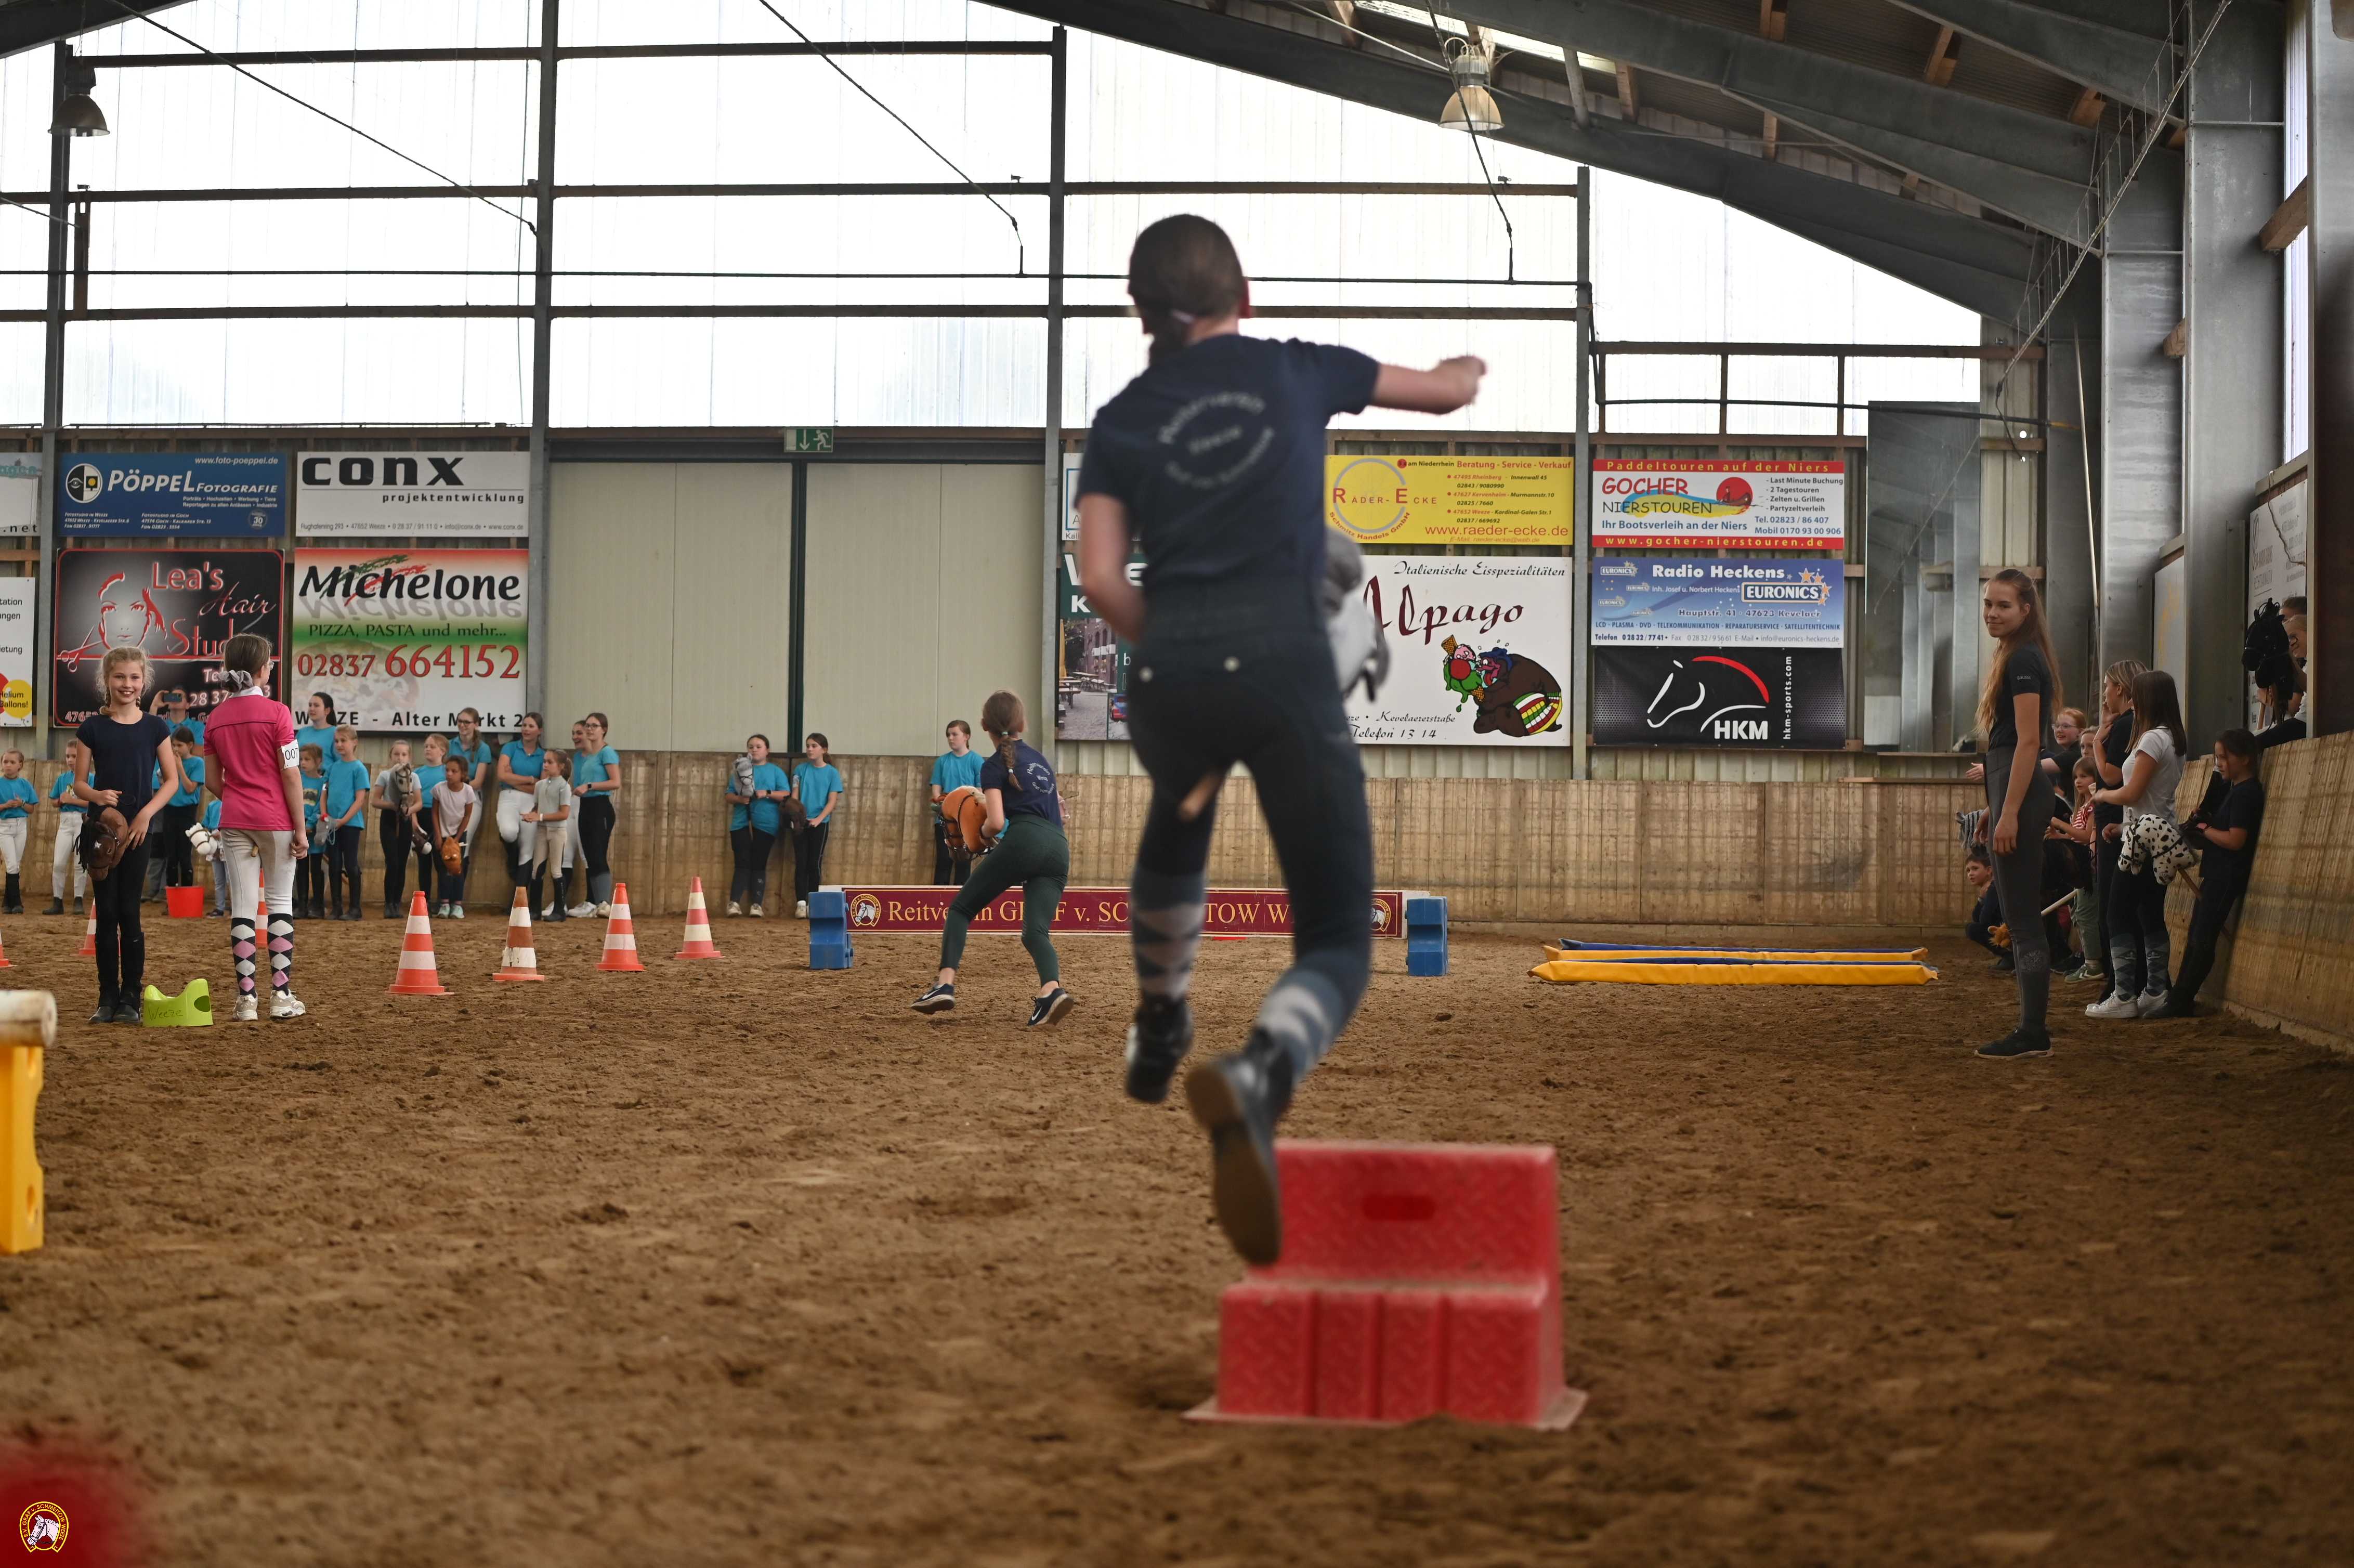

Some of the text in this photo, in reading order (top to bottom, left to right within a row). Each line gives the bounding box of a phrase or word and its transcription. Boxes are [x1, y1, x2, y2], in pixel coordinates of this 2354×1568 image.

[194, 456, 279, 465] www.foto-poeppel.de
[1457, 461, 1495, 469] Beratung
[1607, 461, 1829, 472] Paddeltouren auf der Niers
[302, 457, 464, 486] conx
[1602, 477, 1689, 495] GOCHER
[382, 493, 524, 504] projektentwicklung
[1603, 501, 1712, 514] NIERSTOUREN
[1329, 511, 1355, 537] Schmitz
[1391, 512, 1410, 533] GmbH
[1424, 525, 1568, 536] www.raeder-ecke.de
[1602, 520, 1616, 529] Ihr
[1619, 520, 1683, 529] Bootsverleih
[1701, 521, 1718, 530] der
[1721, 521, 1747, 530] Niers
[1605, 537, 1824, 546] www.gocher-nierstouren.de
[152, 561, 224, 591] Lea's
[1394, 560, 1565, 578] Italienische Eisspezialitäten
[1652, 565, 1785, 578] Radio Heckens
[299, 565, 521, 600] Michelone
[198, 581, 277, 617] Hair
[1747, 586, 1819, 599] EURONICS
[1678, 609, 1722, 617] Hauptstr.
[309, 624, 359, 638] PIZZA,
[365, 624, 415, 637] PASTA
[422, 623, 451, 637] und
[297, 644, 520, 679] 02837 664152
[1783, 656, 1793, 739] hkm-sports.com
[295, 711, 359, 725] WZE
[391, 712, 440, 726] Alter
[448, 713, 505, 727] Mrkt
[1376, 711, 1456, 724] Kevelaererstraße
[1349, 724, 1394, 740] Telefon
[1714, 720, 1768, 739] HKM
[285, 748, 298, 760] 007
[1074, 907, 1090, 922] v.
